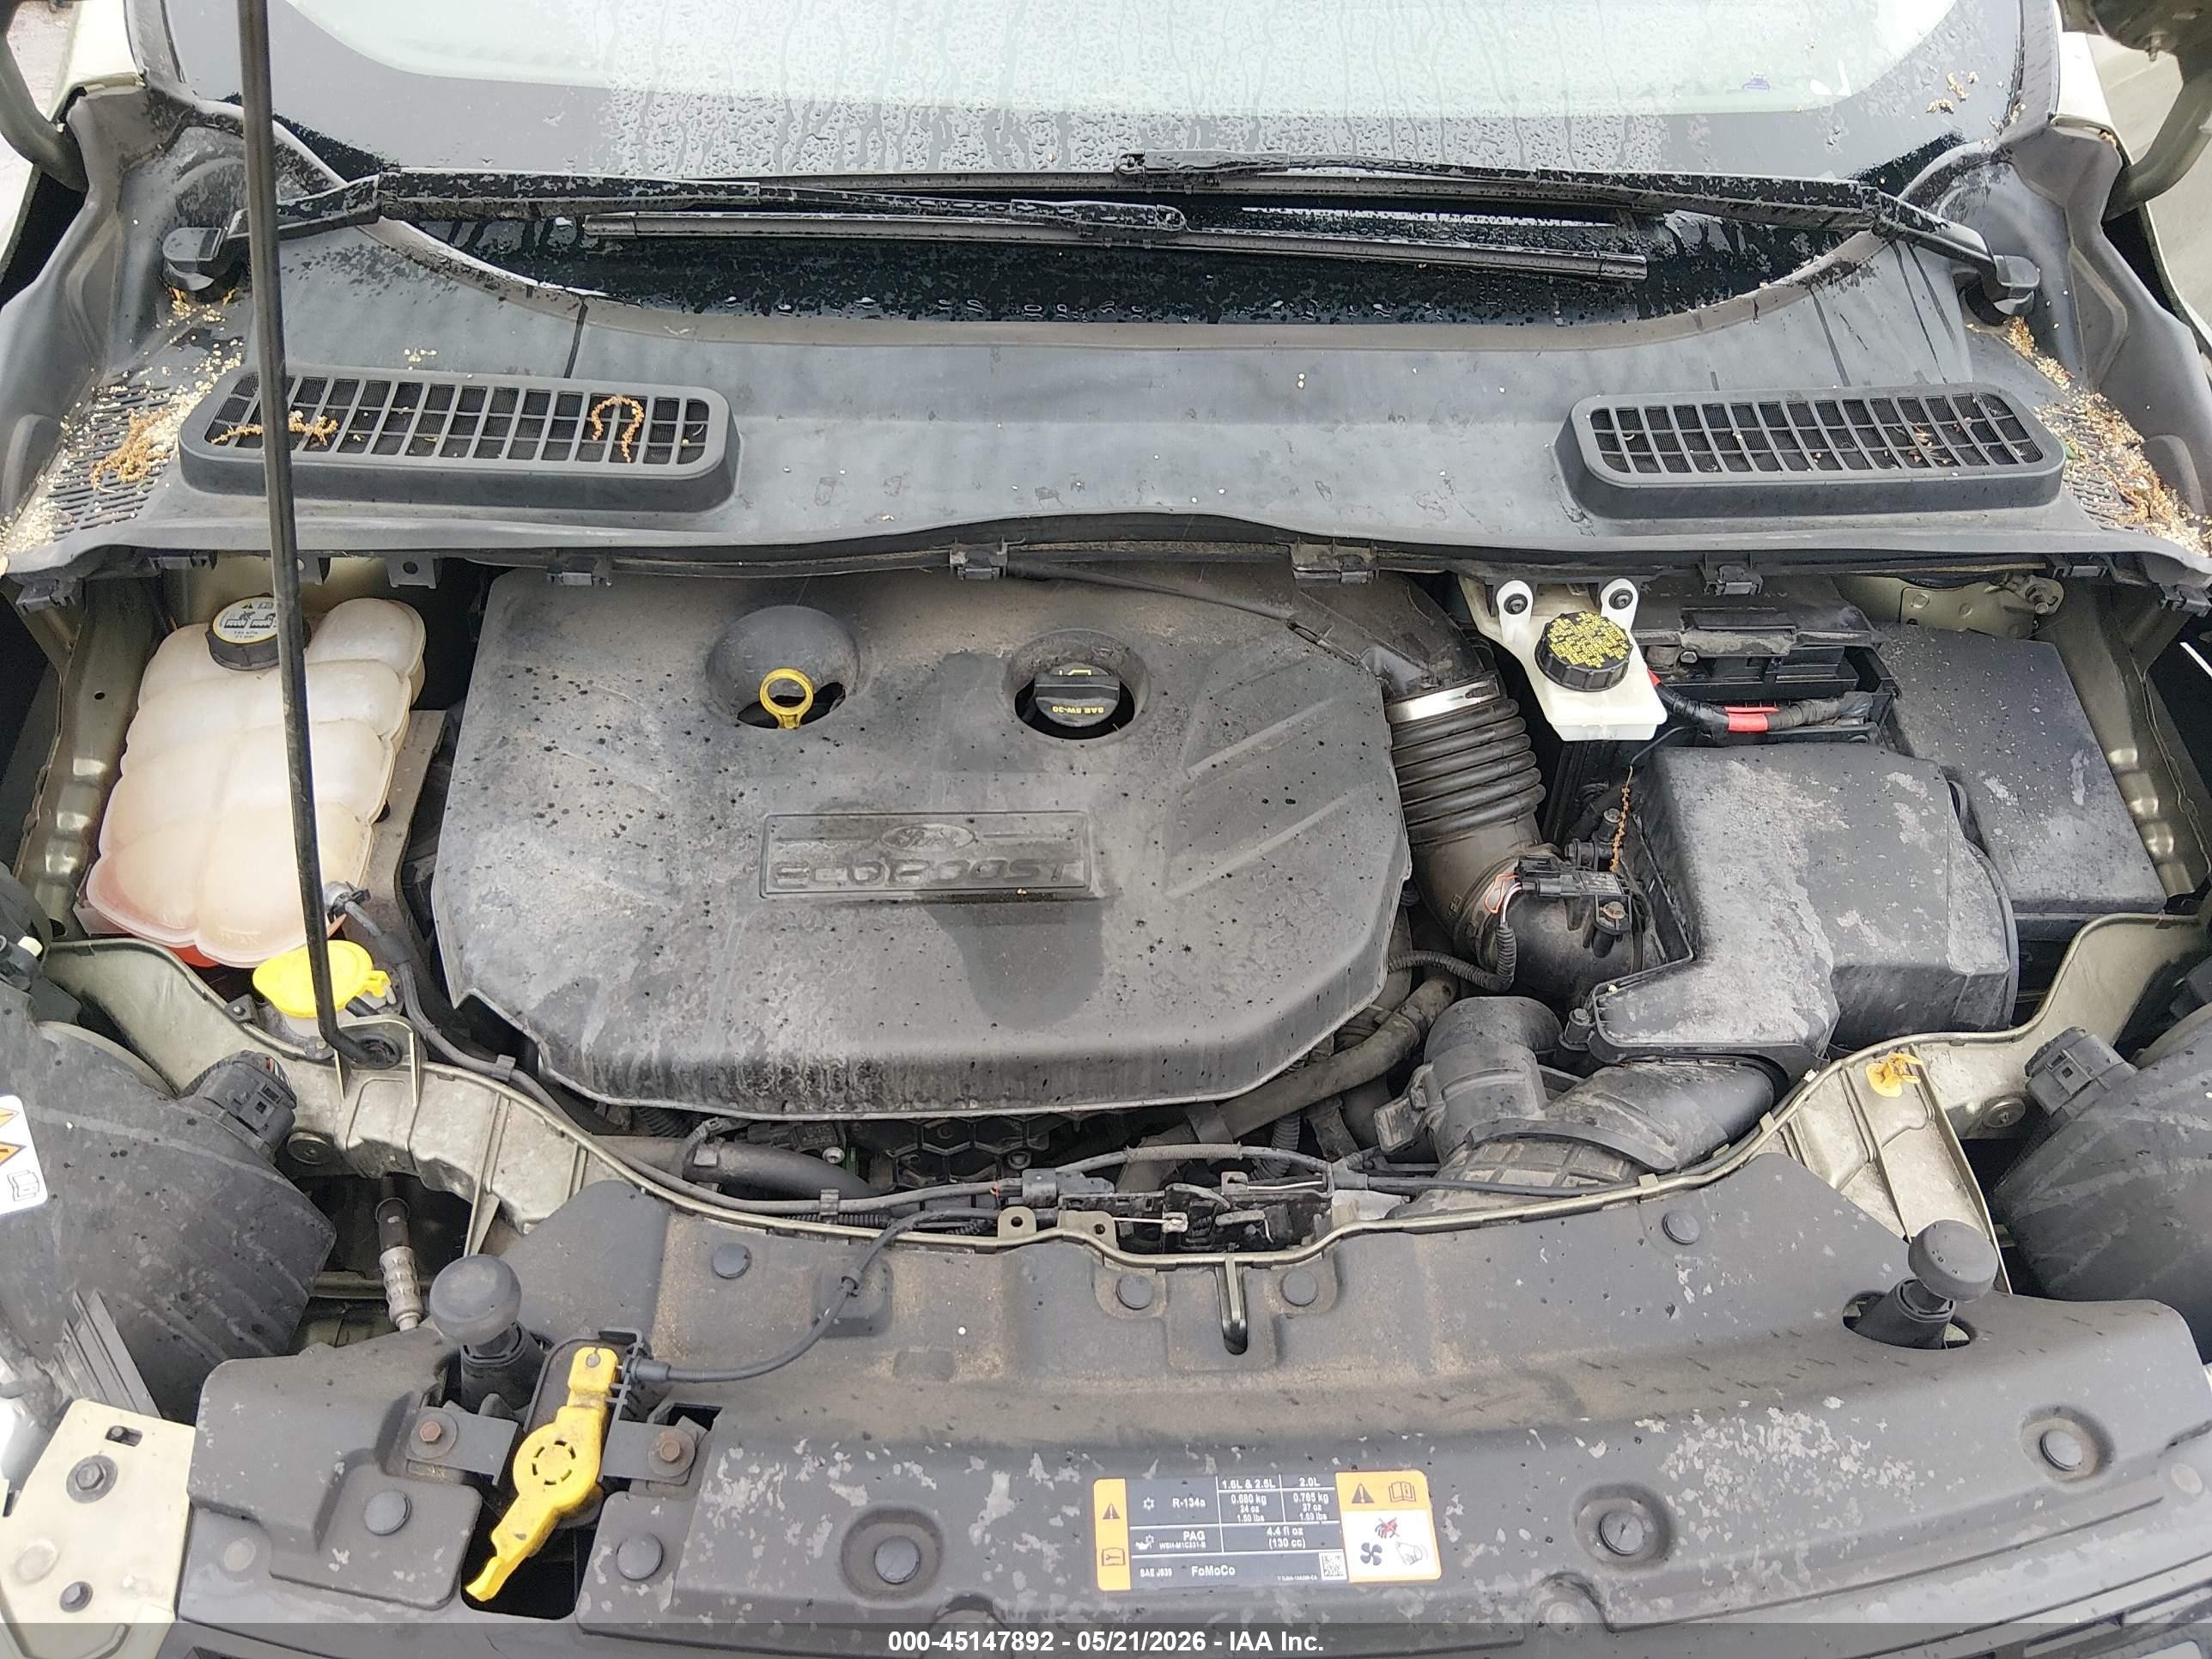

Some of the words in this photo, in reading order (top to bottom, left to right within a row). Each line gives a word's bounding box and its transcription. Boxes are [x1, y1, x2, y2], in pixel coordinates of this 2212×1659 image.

[1245, 1479, 1253, 1489] &
[1298, 1477, 1320, 1487] 2.0L
[1255, 1493, 1267, 1505] kg
[1317, 1492, 1329, 1504] kg
[1172, 1498, 1206, 1509] R-134a
[1253, 1514, 1265, 1522] lbs
[1316, 1512, 1328, 1521] lbs
[1182, 1530, 1206, 1541] PAG
[1266, 1526, 1281, 1536] 4.4
[1283, 1526, 1290, 1535] fl
[1291, 1527, 1304, 1535] oz
[1268, 1537, 1288, 1549] (130
[1291, 1537, 1306, 1548] cc)
[1139, 1568, 1155, 1578] SAE
[1191, 1565, 1236, 1577] FoMoCo
